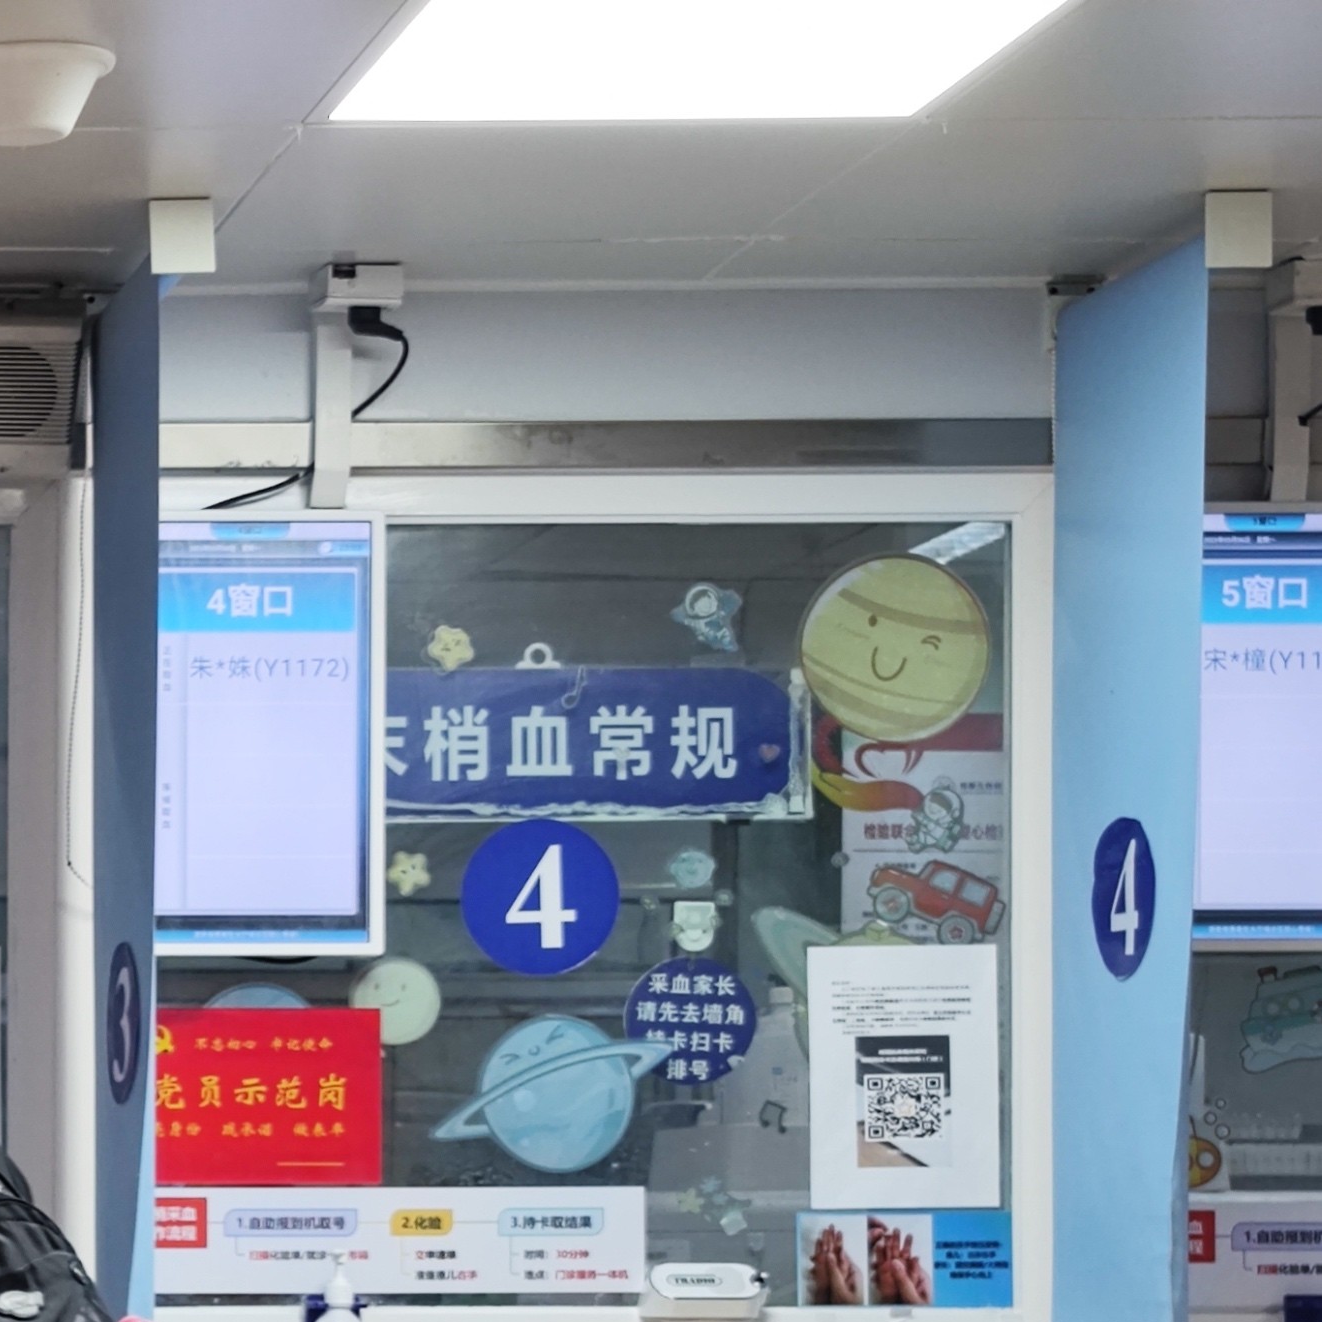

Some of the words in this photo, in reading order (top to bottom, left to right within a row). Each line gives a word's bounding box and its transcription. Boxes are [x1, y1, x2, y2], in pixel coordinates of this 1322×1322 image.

[206, 584, 294, 619] 4窗口
[1221, 574, 1308, 610] 5窗口
[504, 843, 578, 950] 4
[1109, 838, 1139, 955] 4
[647, 973, 736, 997] 采血家长
[111, 965, 134, 1085] 3
[635, 1002, 745, 1026] 请先去墙角
[666, 1058, 711, 1081] 排号
[155, 1073, 348, 1111] 党员示范岗
[155, 1206, 198, 1222] 梢采血
[401, 1215, 443, 1231] 2.化验
[510, 1215, 594, 1231] 3.持卡取结果
